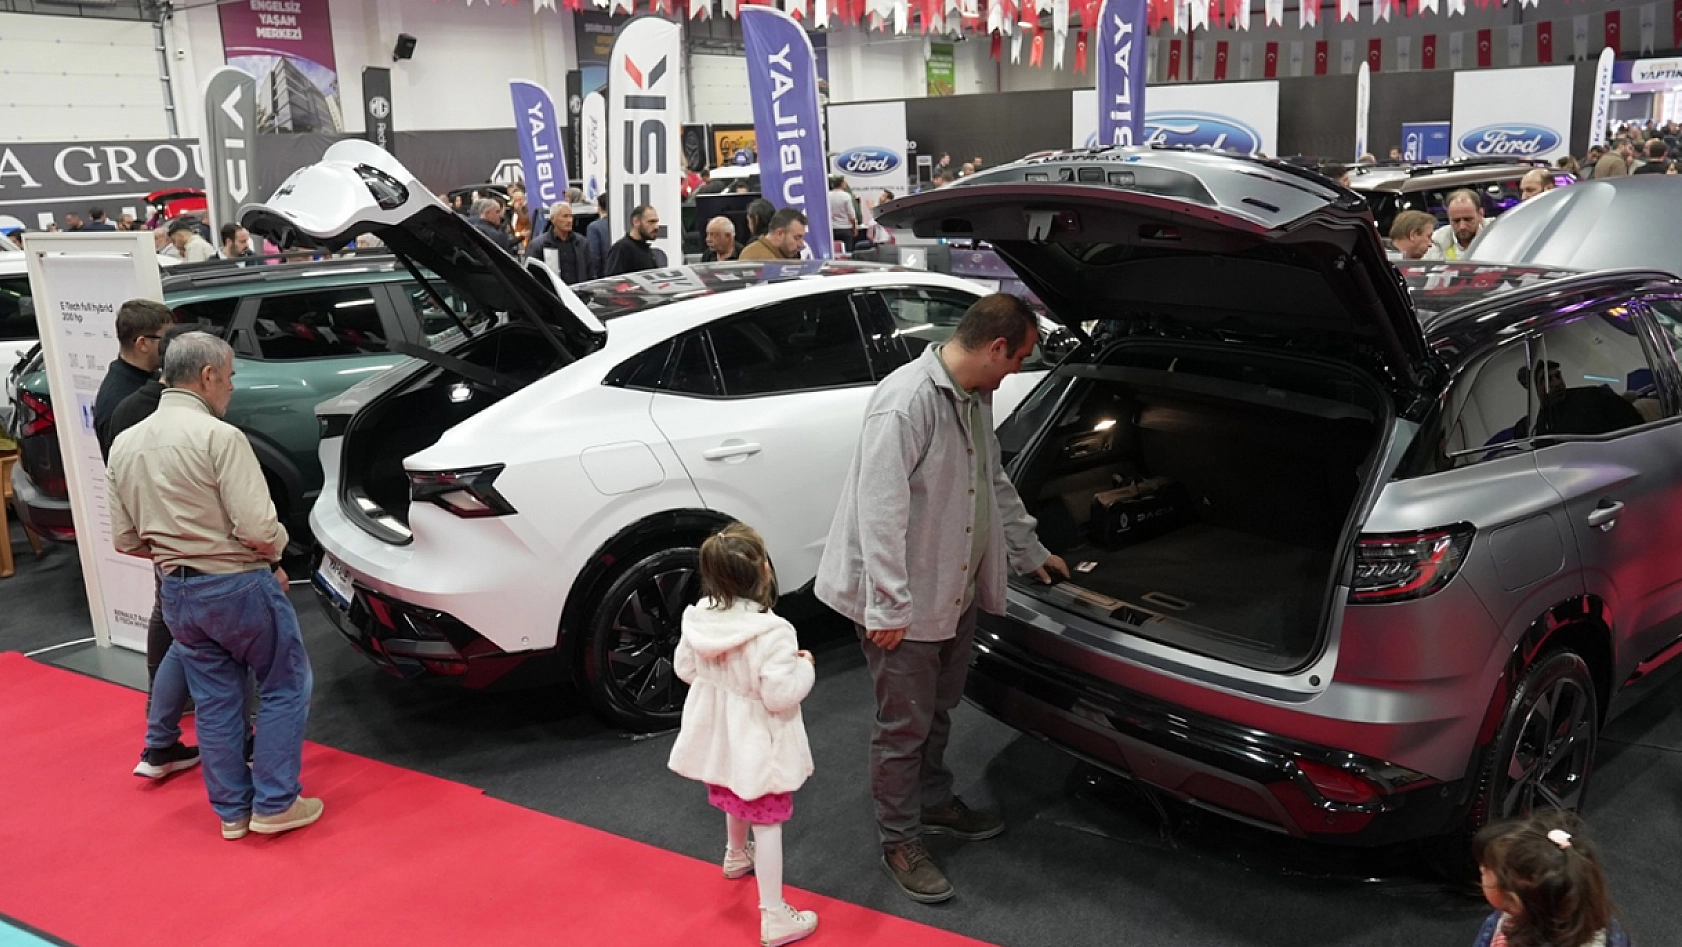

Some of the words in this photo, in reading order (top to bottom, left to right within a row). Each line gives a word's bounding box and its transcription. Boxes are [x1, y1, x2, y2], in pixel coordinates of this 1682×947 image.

[259, 14, 297, 26] YAŞAM
[1475, 129, 1543, 153] Ford
[623, 53, 668, 268] FSK
[846, 151, 889, 171] Ford
